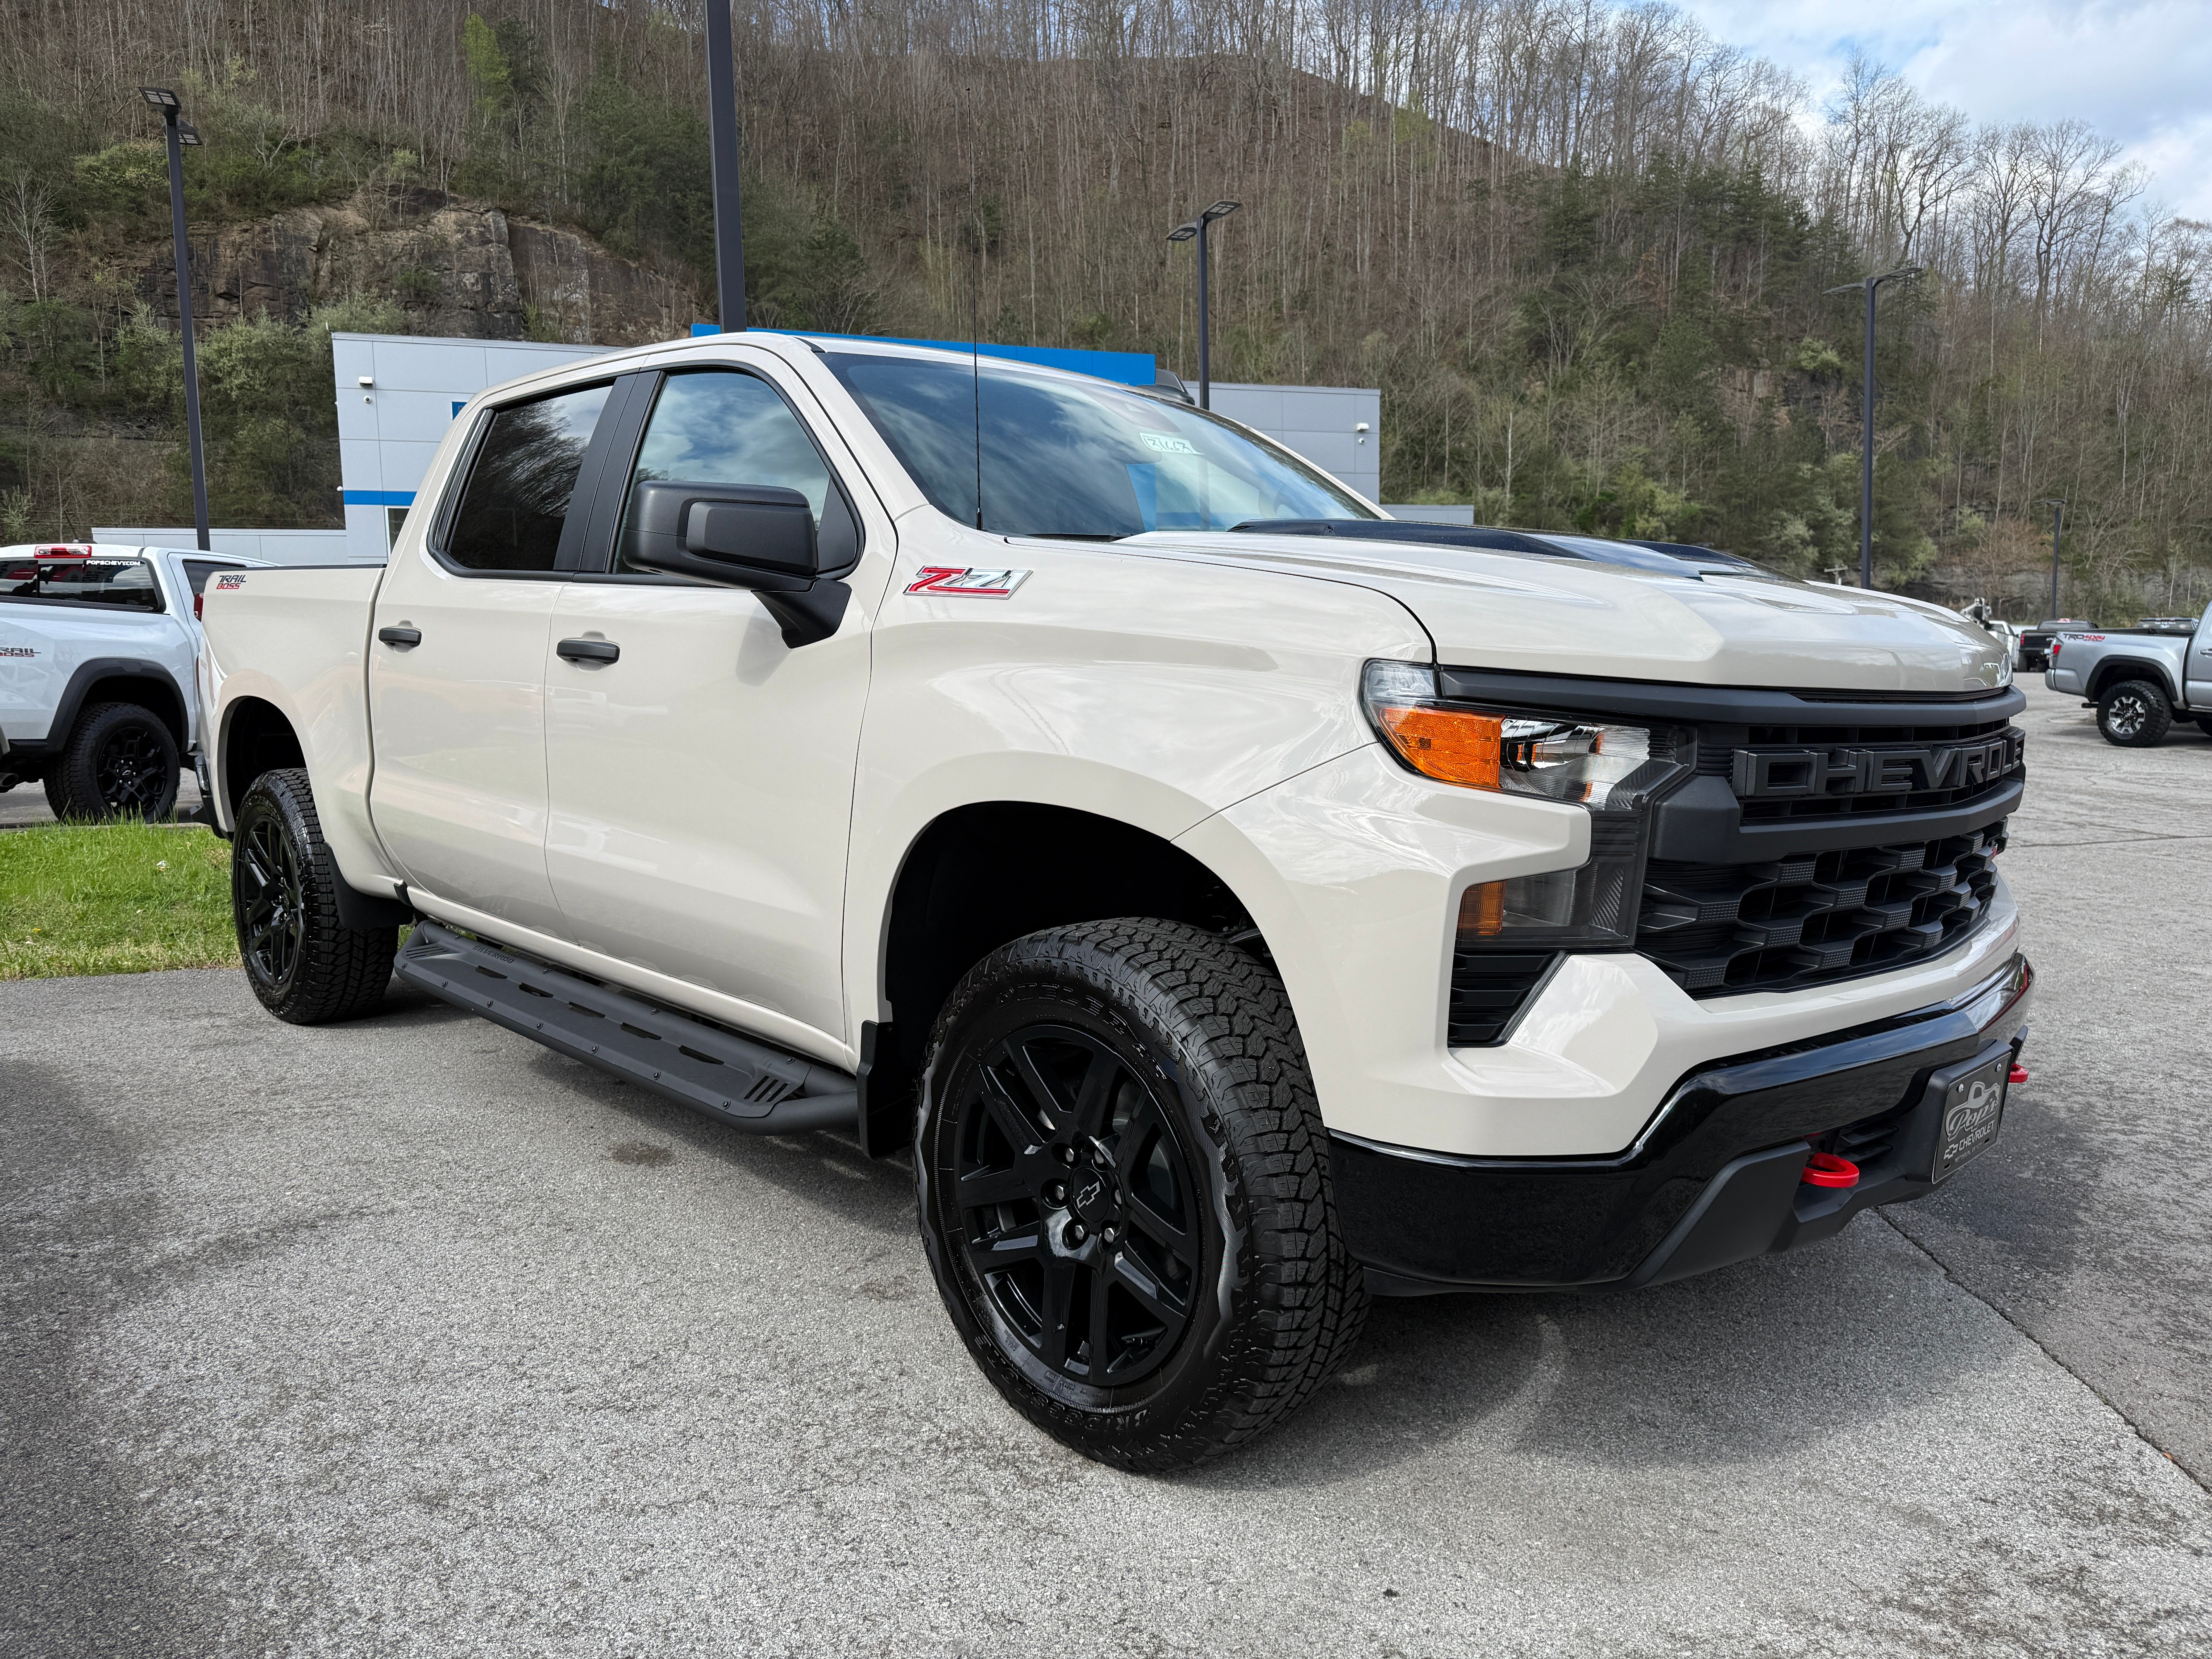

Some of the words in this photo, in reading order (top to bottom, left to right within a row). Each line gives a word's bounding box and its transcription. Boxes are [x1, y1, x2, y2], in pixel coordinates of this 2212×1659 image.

[219, 575, 246, 583] TRAIL
[903, 565, 1034, 600] Z71
[1733, 727, 2026, 798] CHEVROLE
[1959, 1120, 1995, 1151] CHEVROLET
